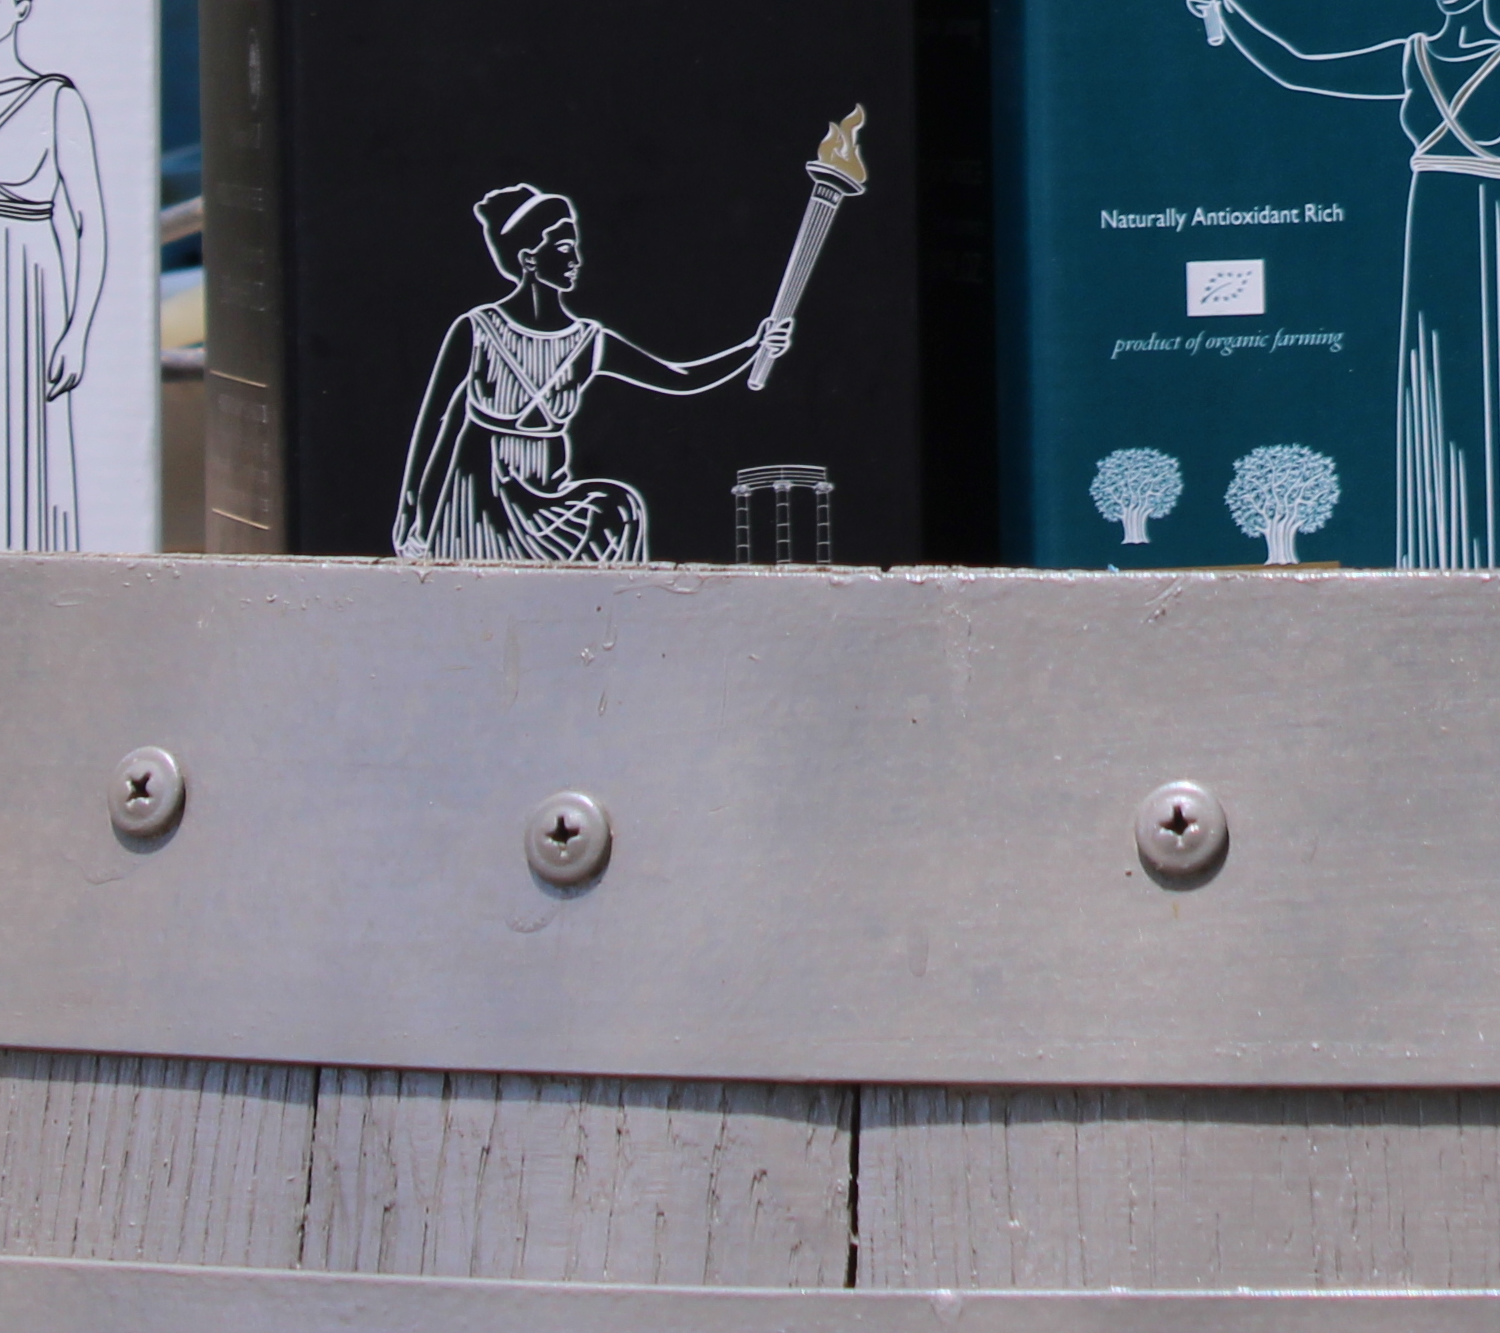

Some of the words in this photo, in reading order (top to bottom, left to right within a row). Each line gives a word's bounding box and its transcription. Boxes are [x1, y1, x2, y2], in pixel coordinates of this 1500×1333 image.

[1101, 207, 1188, 232] Naturally
[1192, 205, 1300, 227] Antioxidant
[1304, 204, 1344, 224] Rich
[1111, 332, 1181, 359] product
[1185, 331, 1204, 354] of
[1204, 331, 1269, 354] organic
[1271, 327, 1344, 353] farming
